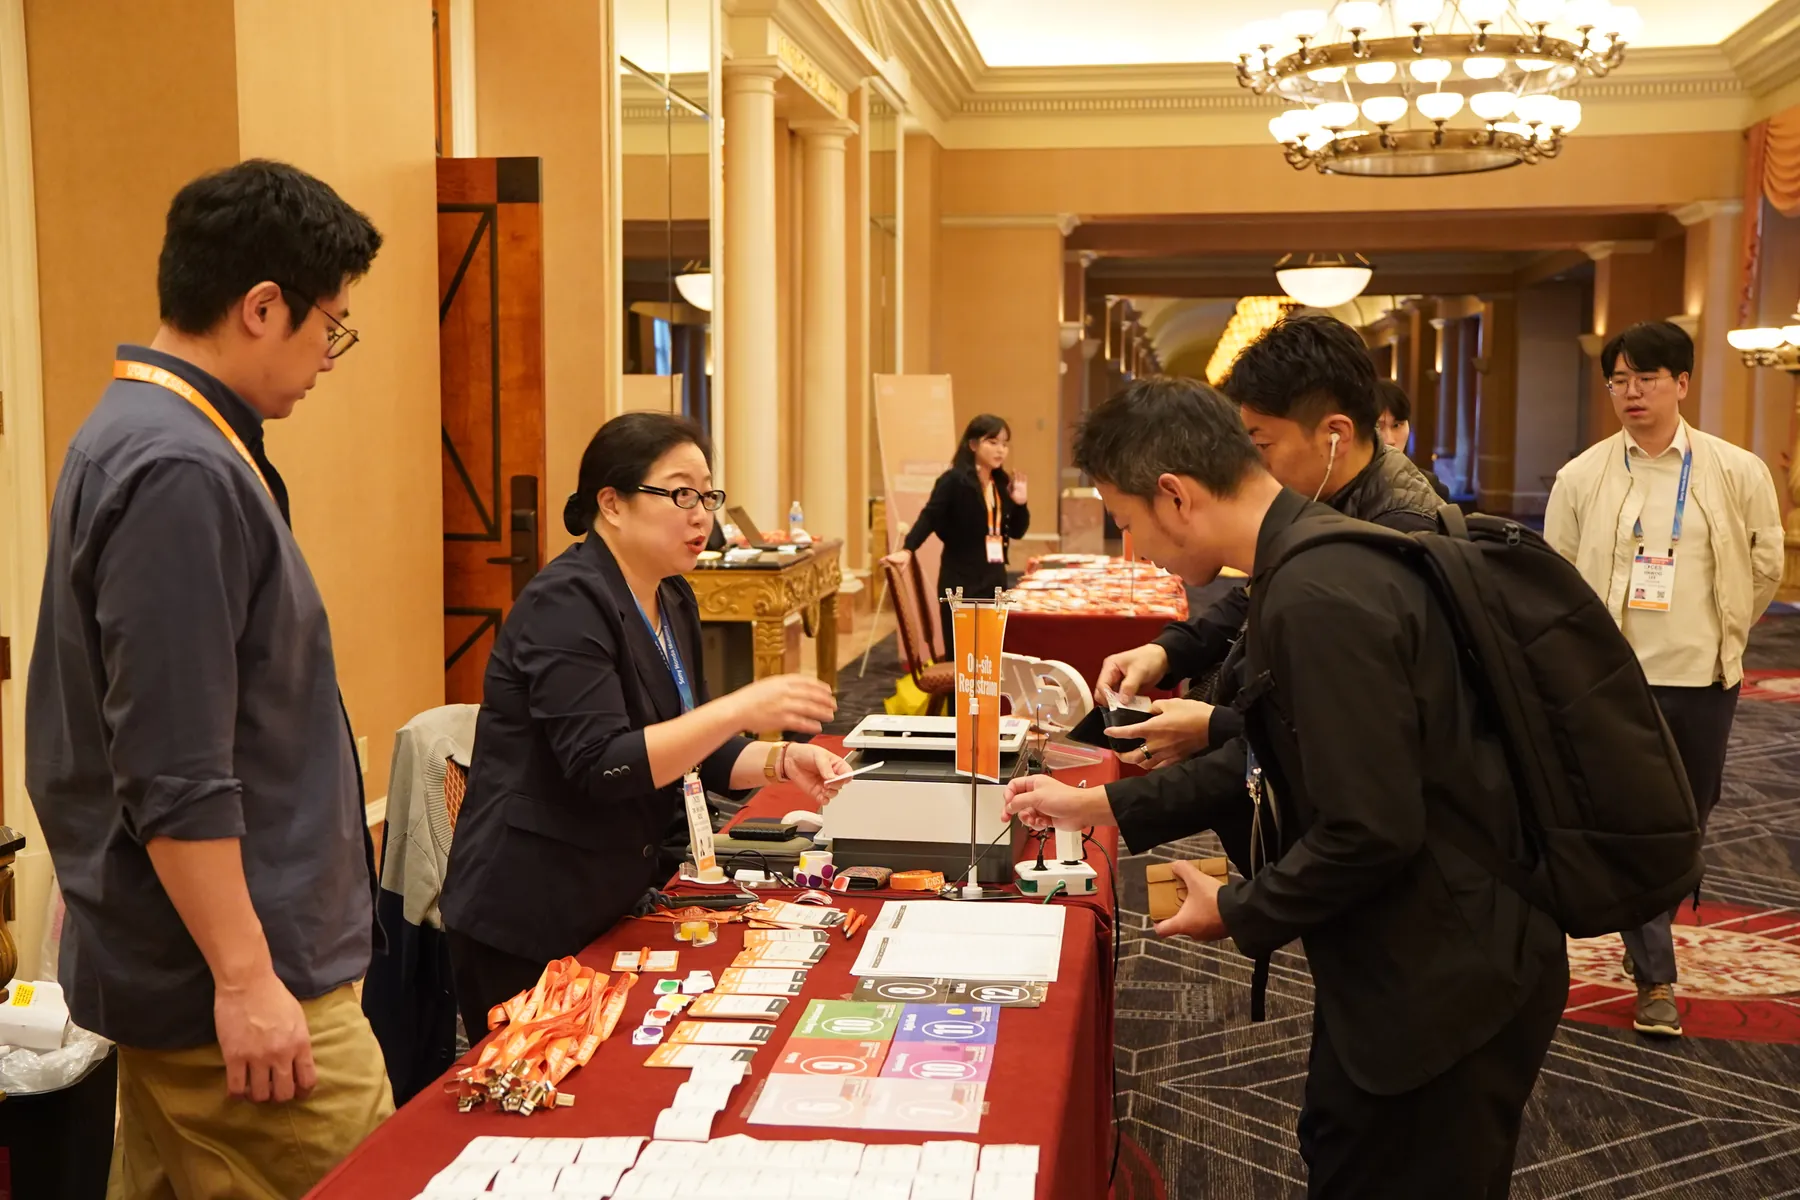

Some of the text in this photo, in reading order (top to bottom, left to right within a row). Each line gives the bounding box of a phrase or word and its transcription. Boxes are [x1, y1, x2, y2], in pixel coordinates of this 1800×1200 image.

[670, 649, 680, 670] Honda
[677, 669, 685, 685] Sony
[887, 987, 927, 995] 8
[981, 988, 1020, 1000] 12
[832, 1019, 874, 1032] 10
[933, 1023, 975, 1034] 11
[920, 1062, 966, 1077] 10
